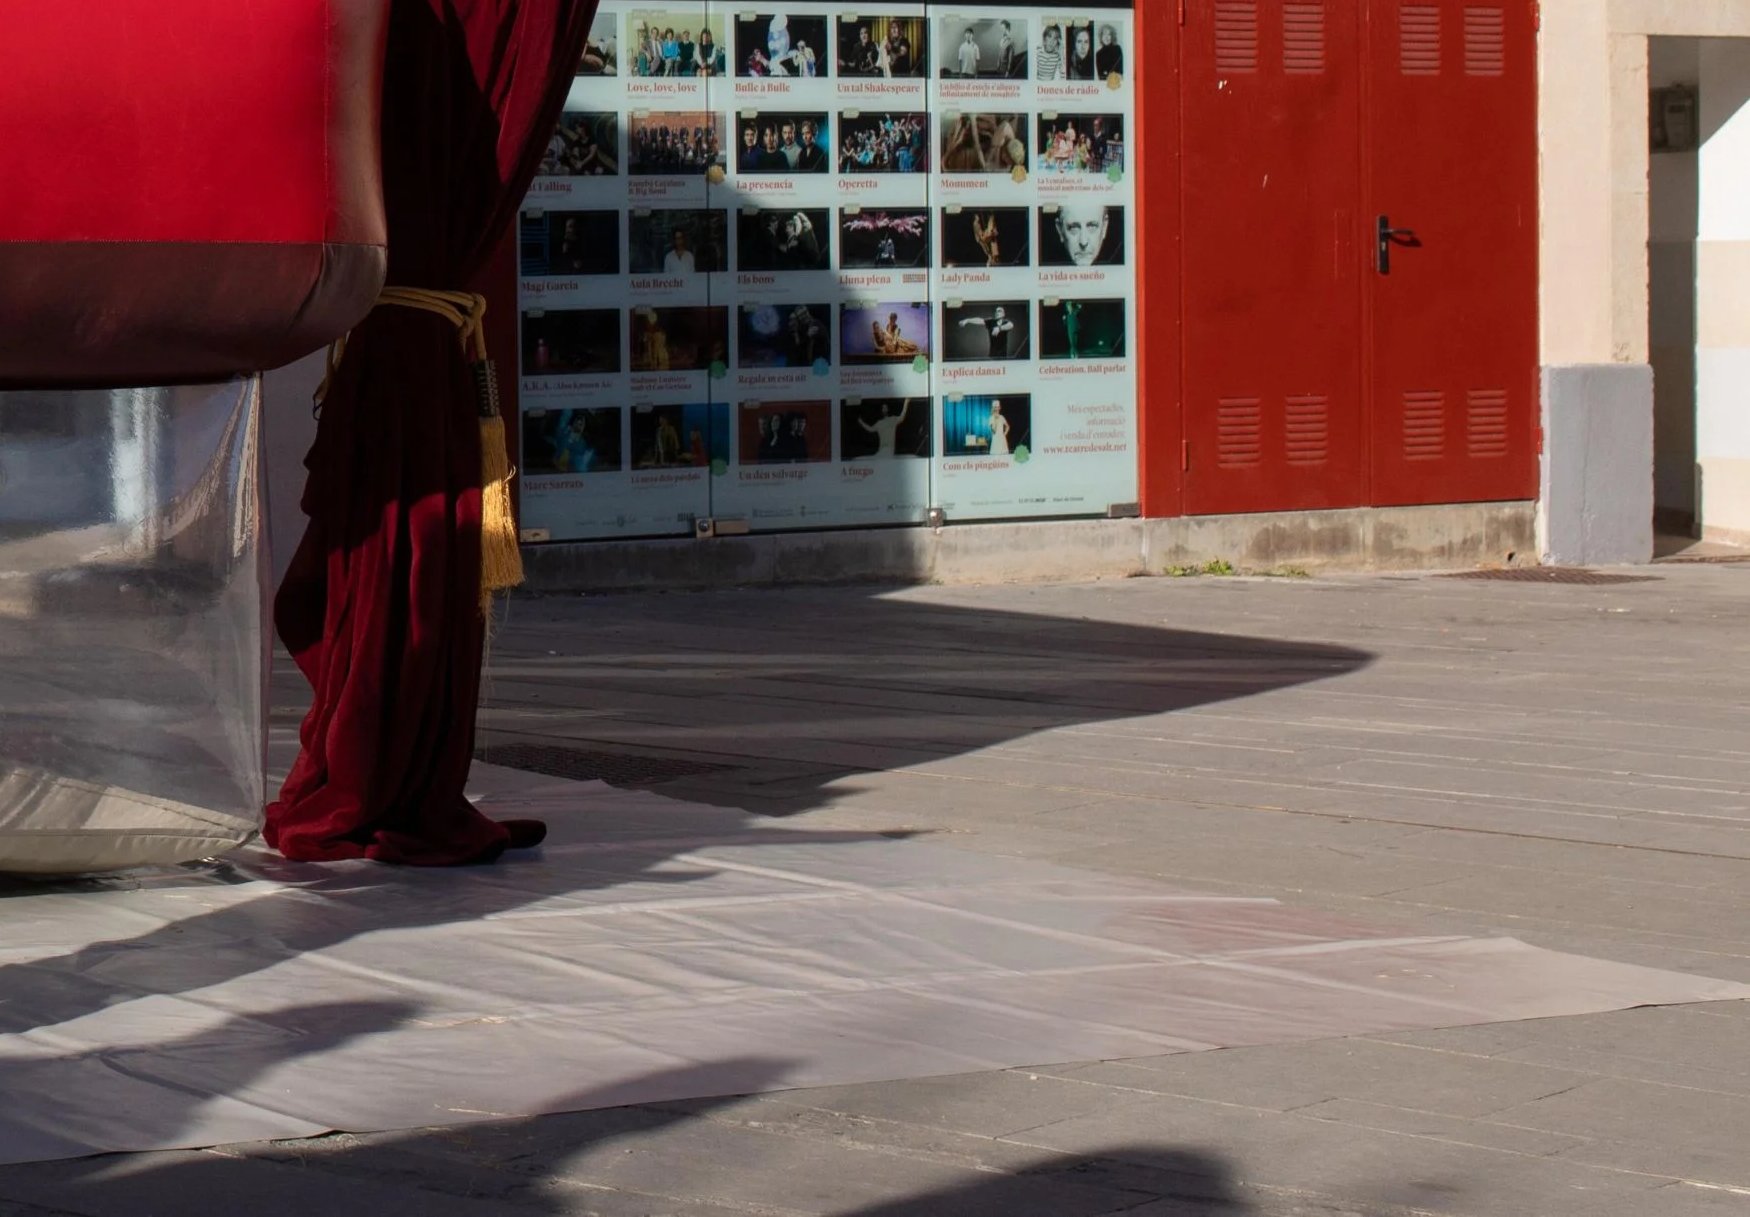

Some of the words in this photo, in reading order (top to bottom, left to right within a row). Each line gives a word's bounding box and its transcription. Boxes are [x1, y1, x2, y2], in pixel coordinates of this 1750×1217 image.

[627, 82, 652, 93] Love,
[654, 82, 675, 93] love,
[677, 82, 697, 93] love
[735, 82, 759, 93] Bulle
[767, 82, 791, 93] Bulle
[837, 83, 851, 93] Un
[851, 83, 864, 93] tal
[864, 83, 921, 95] Shakespeare
[1037, 85, 1064, 95] Dones
[1065, 85, 1075, 95] de
[539, 181, 572, 193] Falling
[736, 180, 747, 190] La
[838, 179, 878, 190] Operetta
[941, 178, 989, 189] Monument
[866, 274, 891, 287] plena
[941, 273, 962, 284] Lady
[963, 272, 991, 282] Panda
[1038, 272, 1050, 281] La
[1050, 272, 1068, 281] vida
[1069, 273, 1078, 281] es
[1079, 272, 1105, 280] sueño
[942, 367, 974, 379] Explica
[975, 367, 1001, 376] dansa
[942, 463, 961, 471] Com
[962, 462, 974, 470] els
